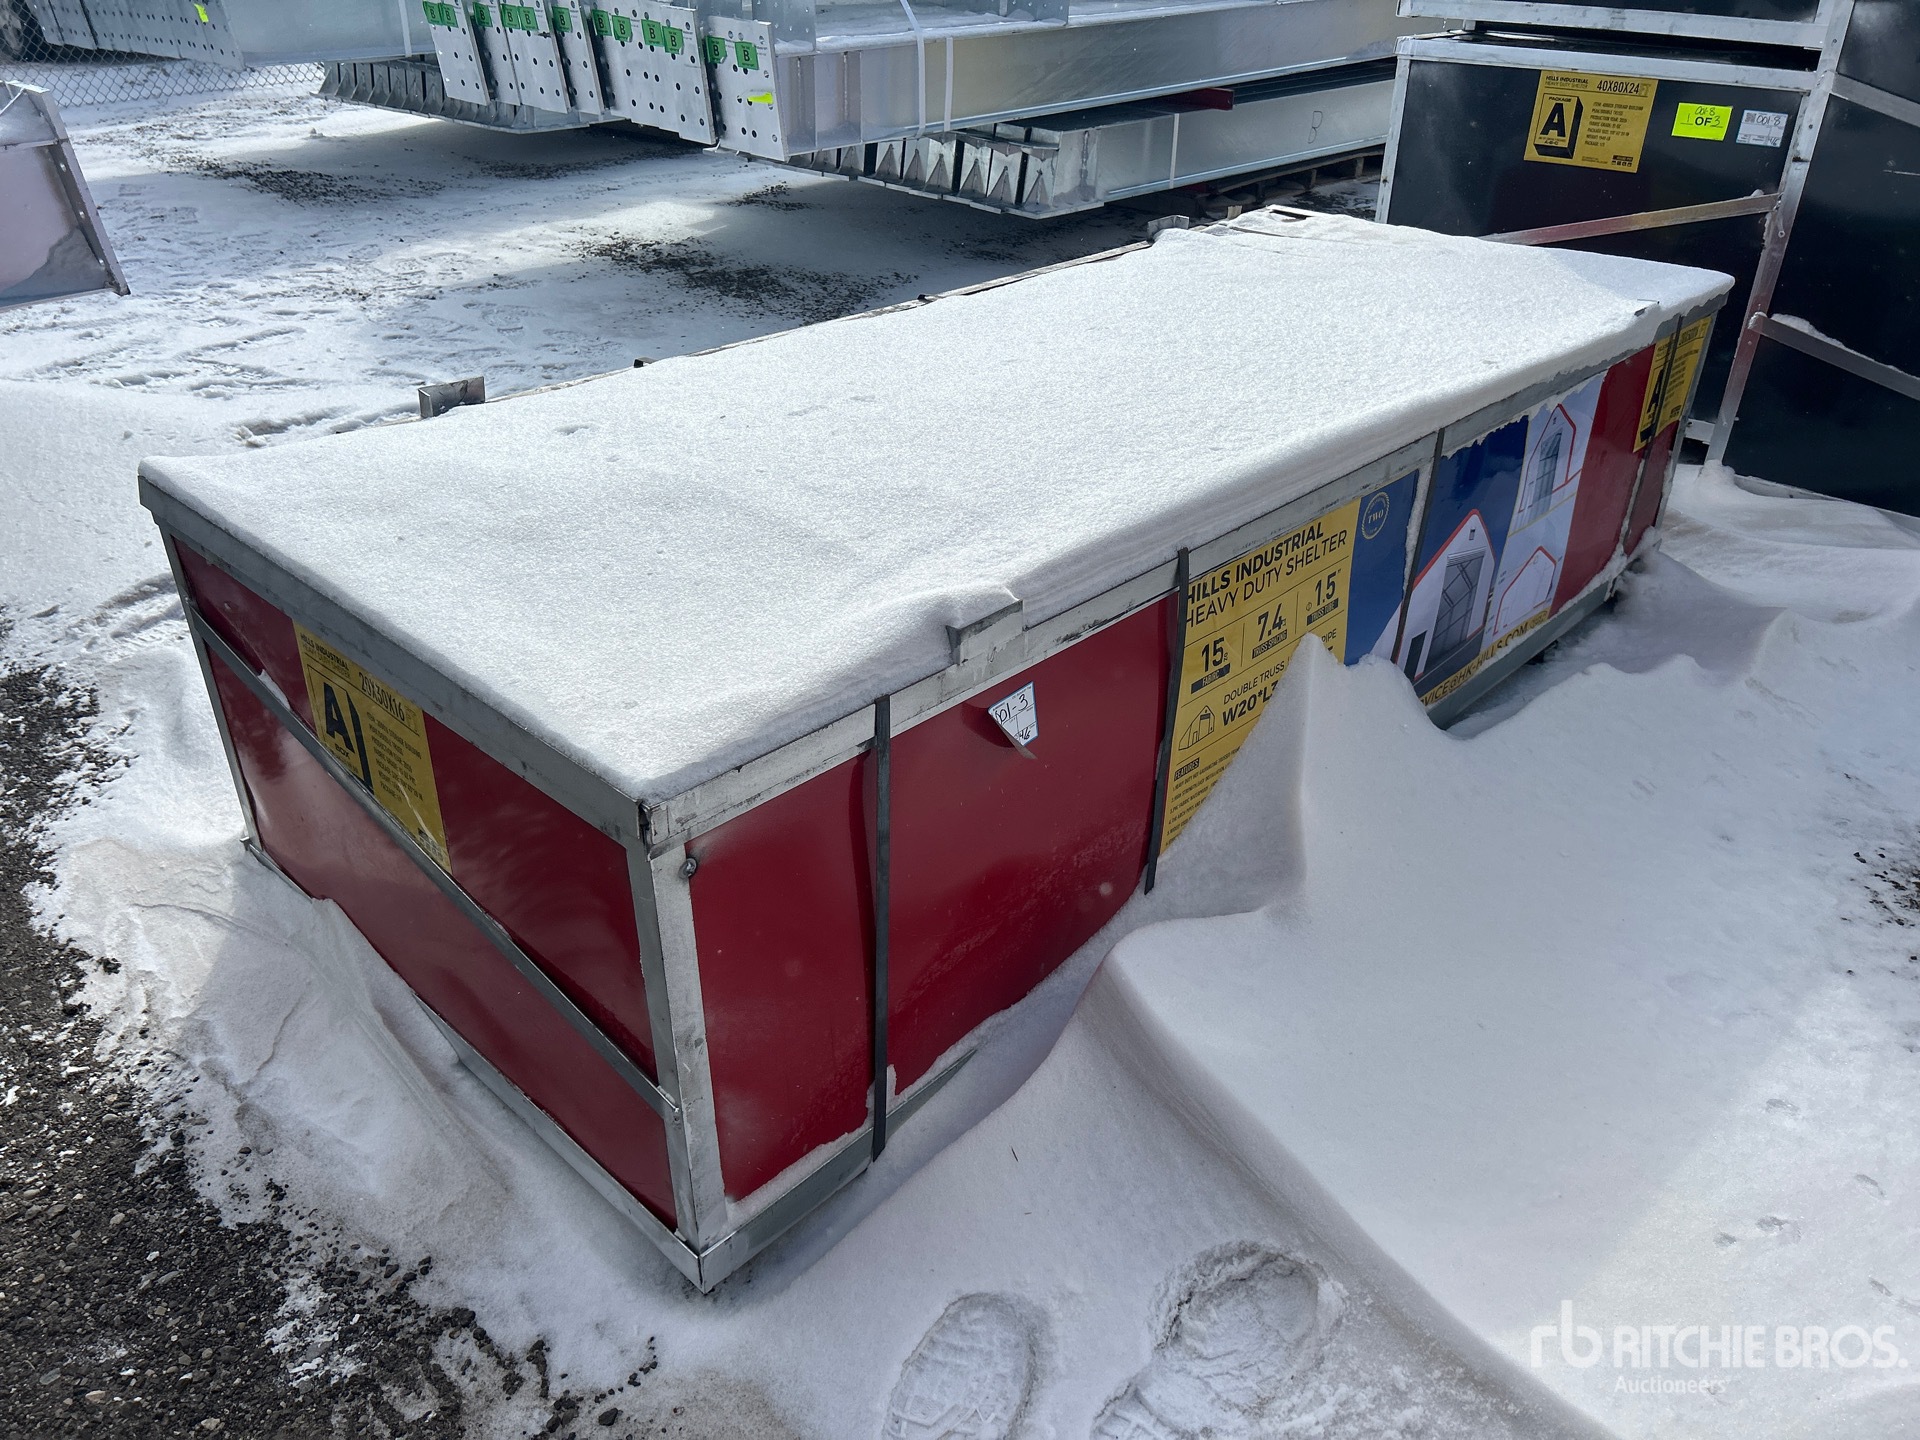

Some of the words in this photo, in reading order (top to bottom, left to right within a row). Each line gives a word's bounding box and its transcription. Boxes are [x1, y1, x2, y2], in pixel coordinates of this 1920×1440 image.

[1596, 80, 1640, 94] 40X80X24
[1540, 103, 1566, 138] A
[1695, 116, 1712, 126] OF
[1186, 587, 1239, 628] HEAVY
[1243, 563, 1282, 601] DUTY
[1286, 530, 1348, 576] SHELTER
[1187, 570, 1230, 604] HILLS
[1236, 522, 1324, 583] INDUSTRIAL
[1258, 602, 1284, 642] 7.4
[1202, 636, 1224, 672] 15
[1224, 676, 1258, 706] DOUBLE
[1260, 660, 1284, 683] TRUSS
[324, 682, 355, 754] A
[1174, 758, 1200, 781] FEATURES
